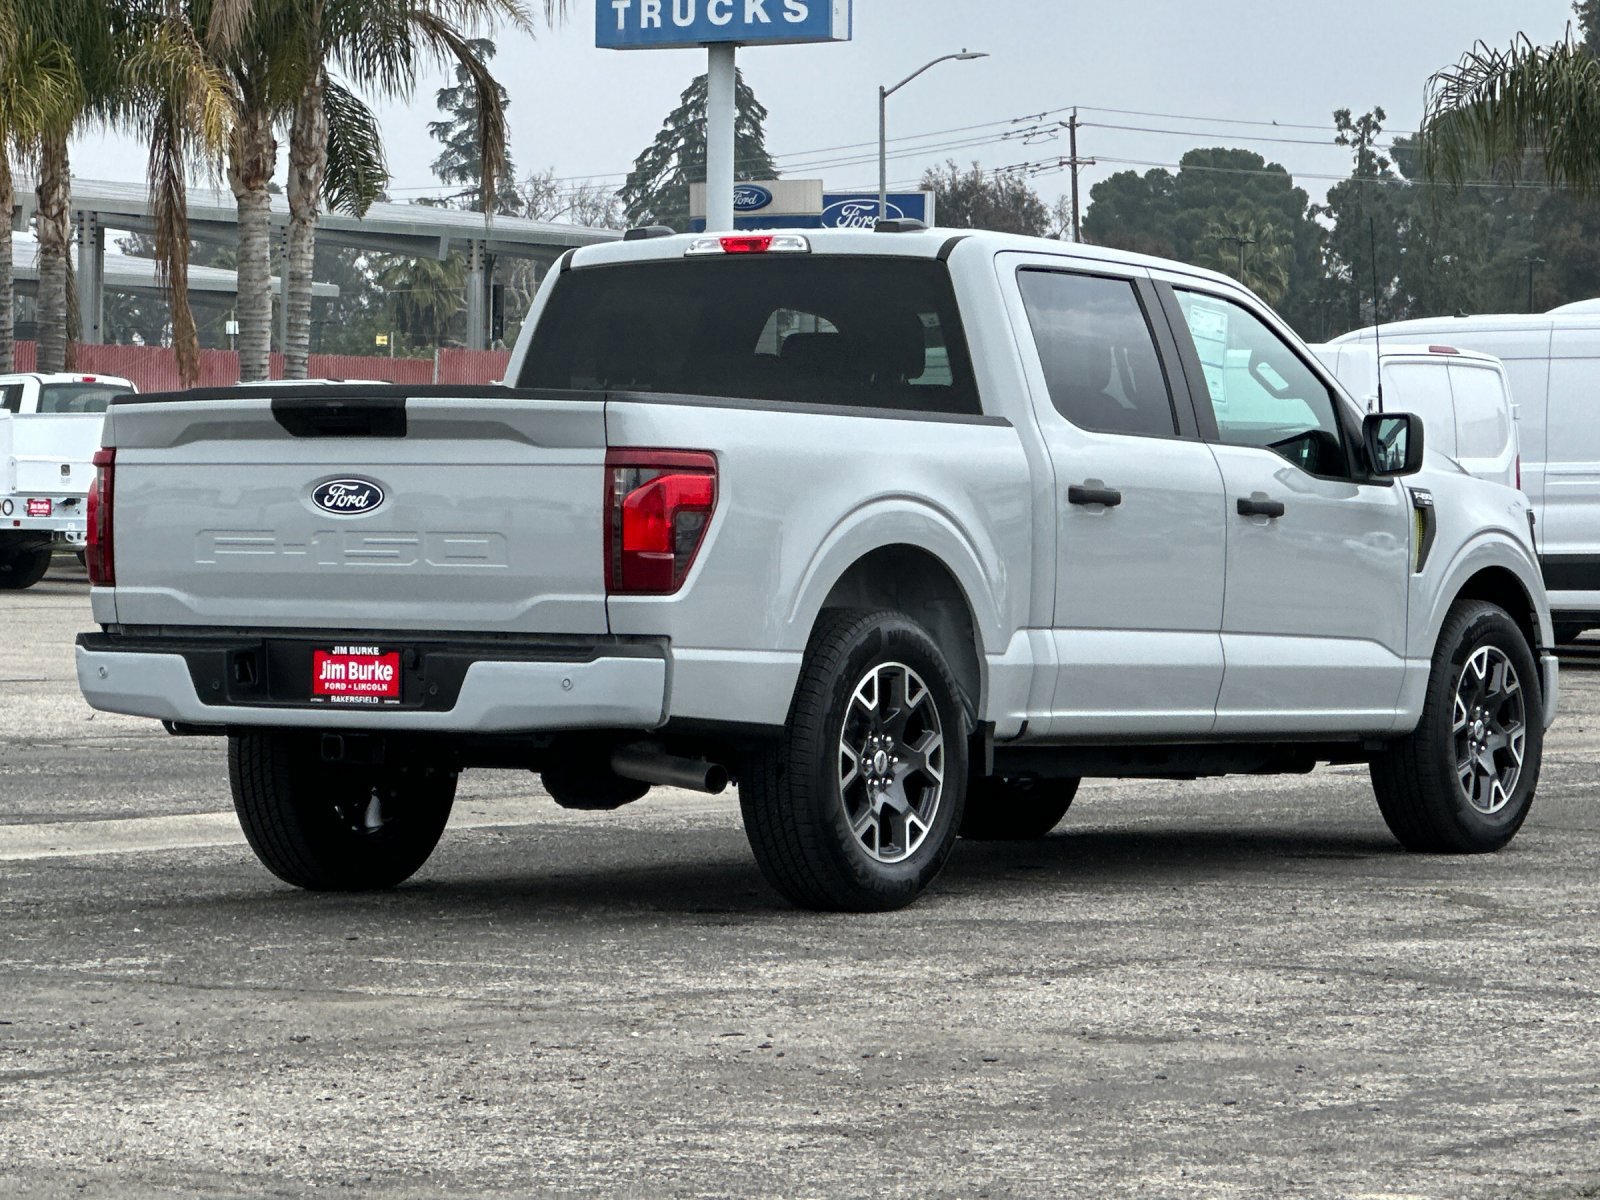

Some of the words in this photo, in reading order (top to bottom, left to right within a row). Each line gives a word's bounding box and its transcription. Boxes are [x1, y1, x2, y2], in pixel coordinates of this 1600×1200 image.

[611, 0, 809, 30] TRUCKS
[323, 483, 370, 507] Ford
[195, 528, 509, 568] F-150
[332, 646, 348, 655] JIM
[349, 646, 380, 656] BURKE
[319, 660, 346, 680] Jim
[348, 661, 394, 681] Burke
[324, 682, 347, 690] FORD
[353, 683, 388, 691] LINCOLN
[330, 695, 379, 704] BAKERSFIELD
